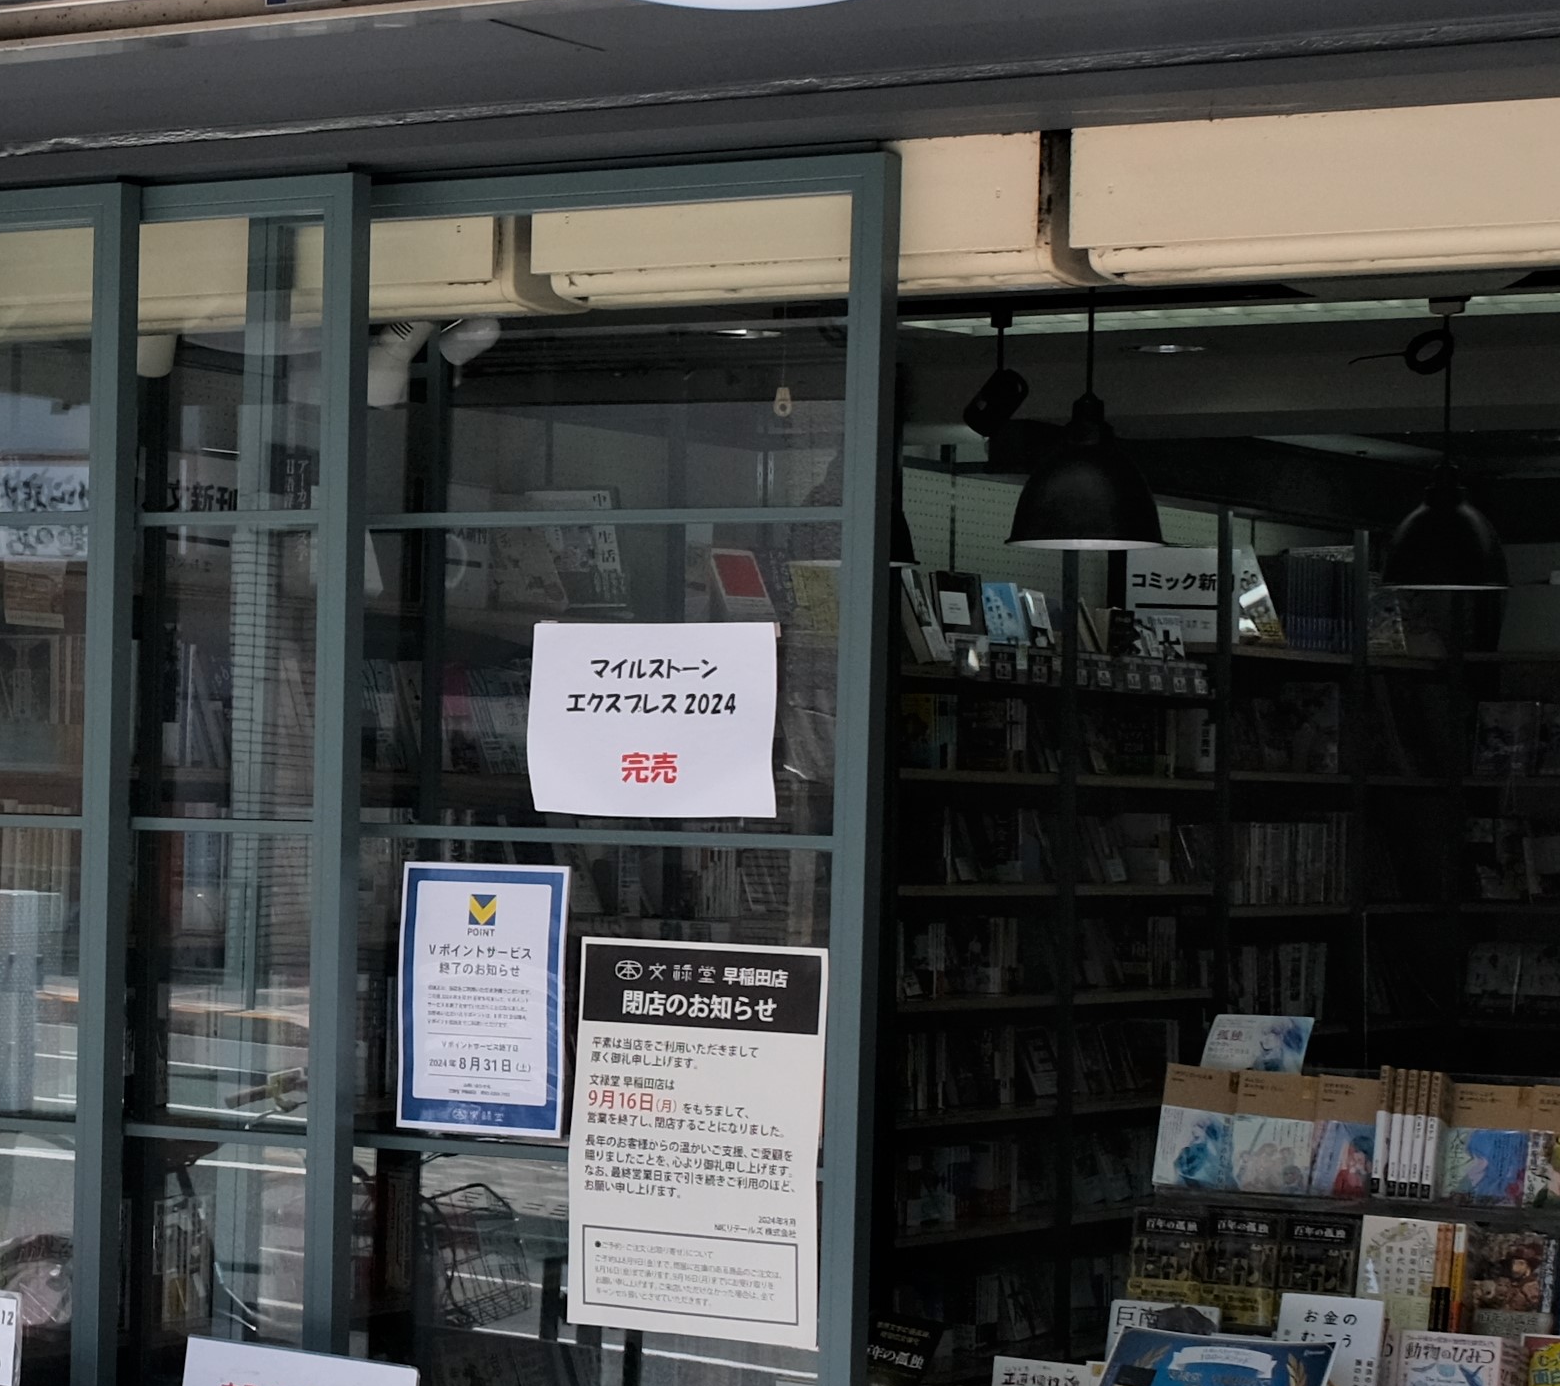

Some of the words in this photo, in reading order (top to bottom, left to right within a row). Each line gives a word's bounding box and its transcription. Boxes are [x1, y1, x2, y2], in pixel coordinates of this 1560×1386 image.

[1132, 572, 1234, 592] コミック新
[590, 657, 719, 681] マイルストーン
[566, 692, 679, 717] エクスプレス
[684, 692, 738, 716] 2024
[620, 751, 679, 784] 完売
[467, 928, 496, 937] POINT
[439, 962, 520, 978] 終了のお知らせ
[722, 966, 789, 989] 早稲田店
[621, 989, 778, 1022] 閉店のお知らせ
[591, 1036, 760, 1059] 平素は当店をご利用いただきまして
[590, 1051, 699, 1071] 厚く御礼申し上げます。
[586, 1112, 785, 1139] 営業を終了し、閉店することになりました。
